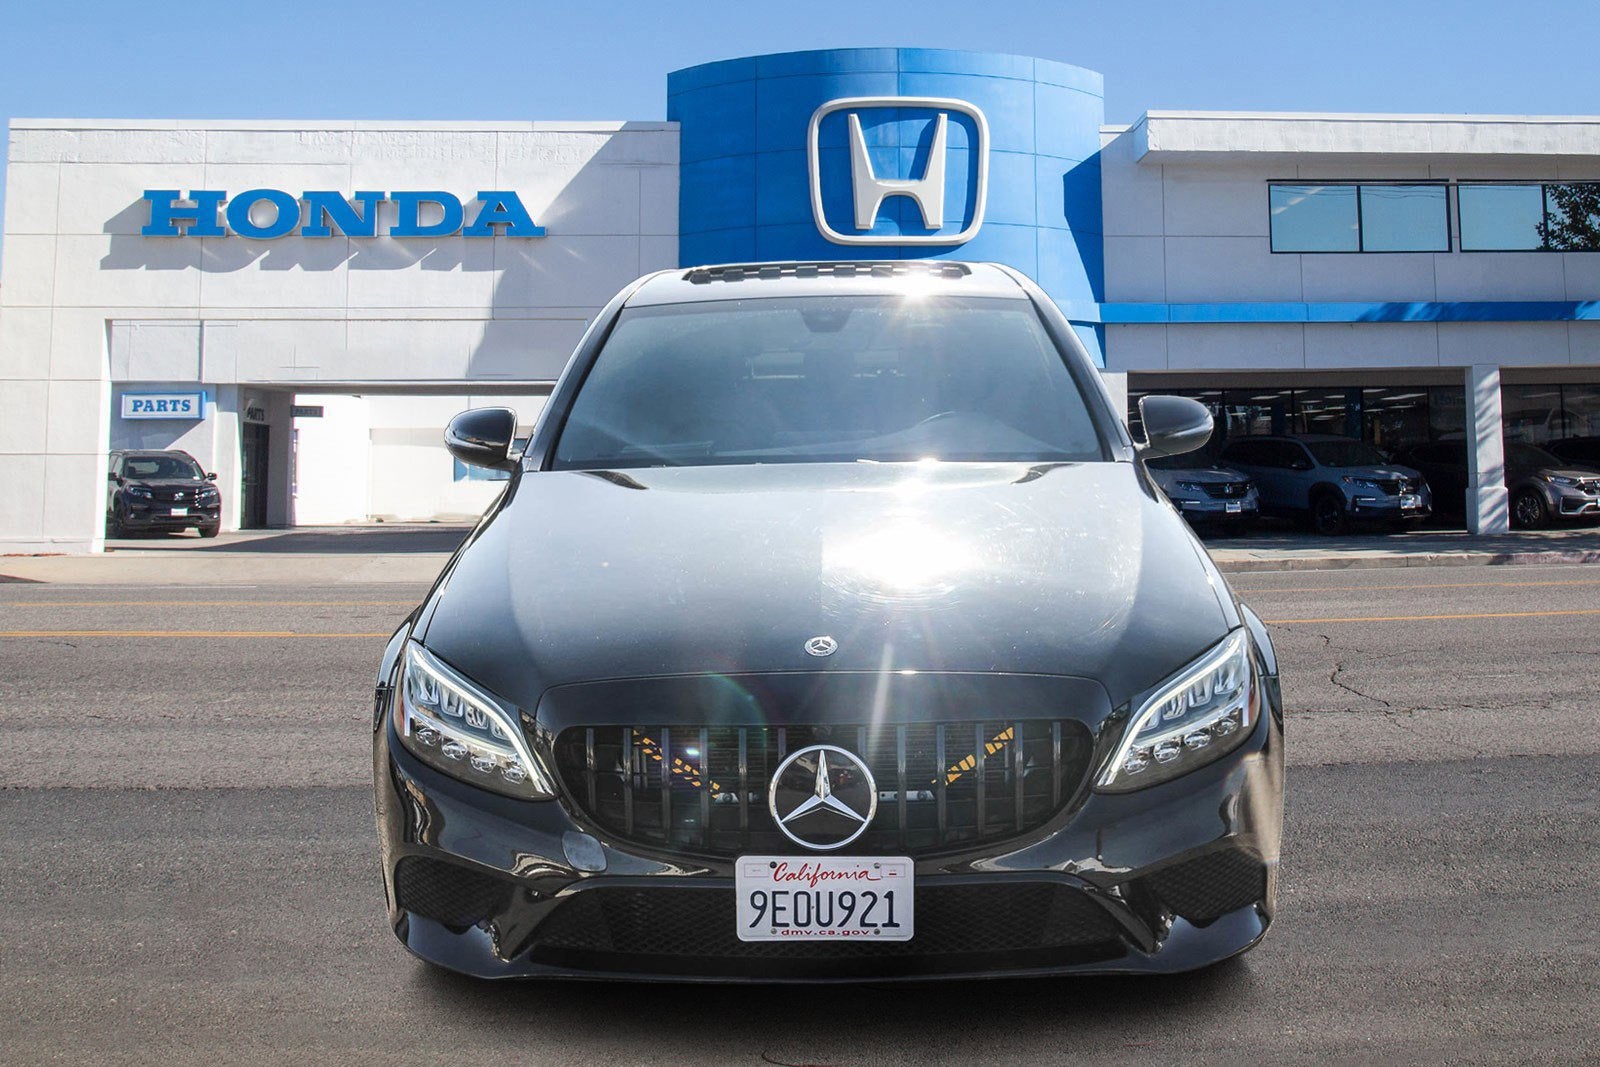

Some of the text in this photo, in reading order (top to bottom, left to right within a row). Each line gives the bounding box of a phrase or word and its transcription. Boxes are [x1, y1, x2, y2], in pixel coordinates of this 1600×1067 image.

[142, 189, 547, 239] HONDA
[132, 400, 191, 412] PARTS
[773, 862, 882, 888] California
[781, 929, 870, 937] dmv.ca.gov
